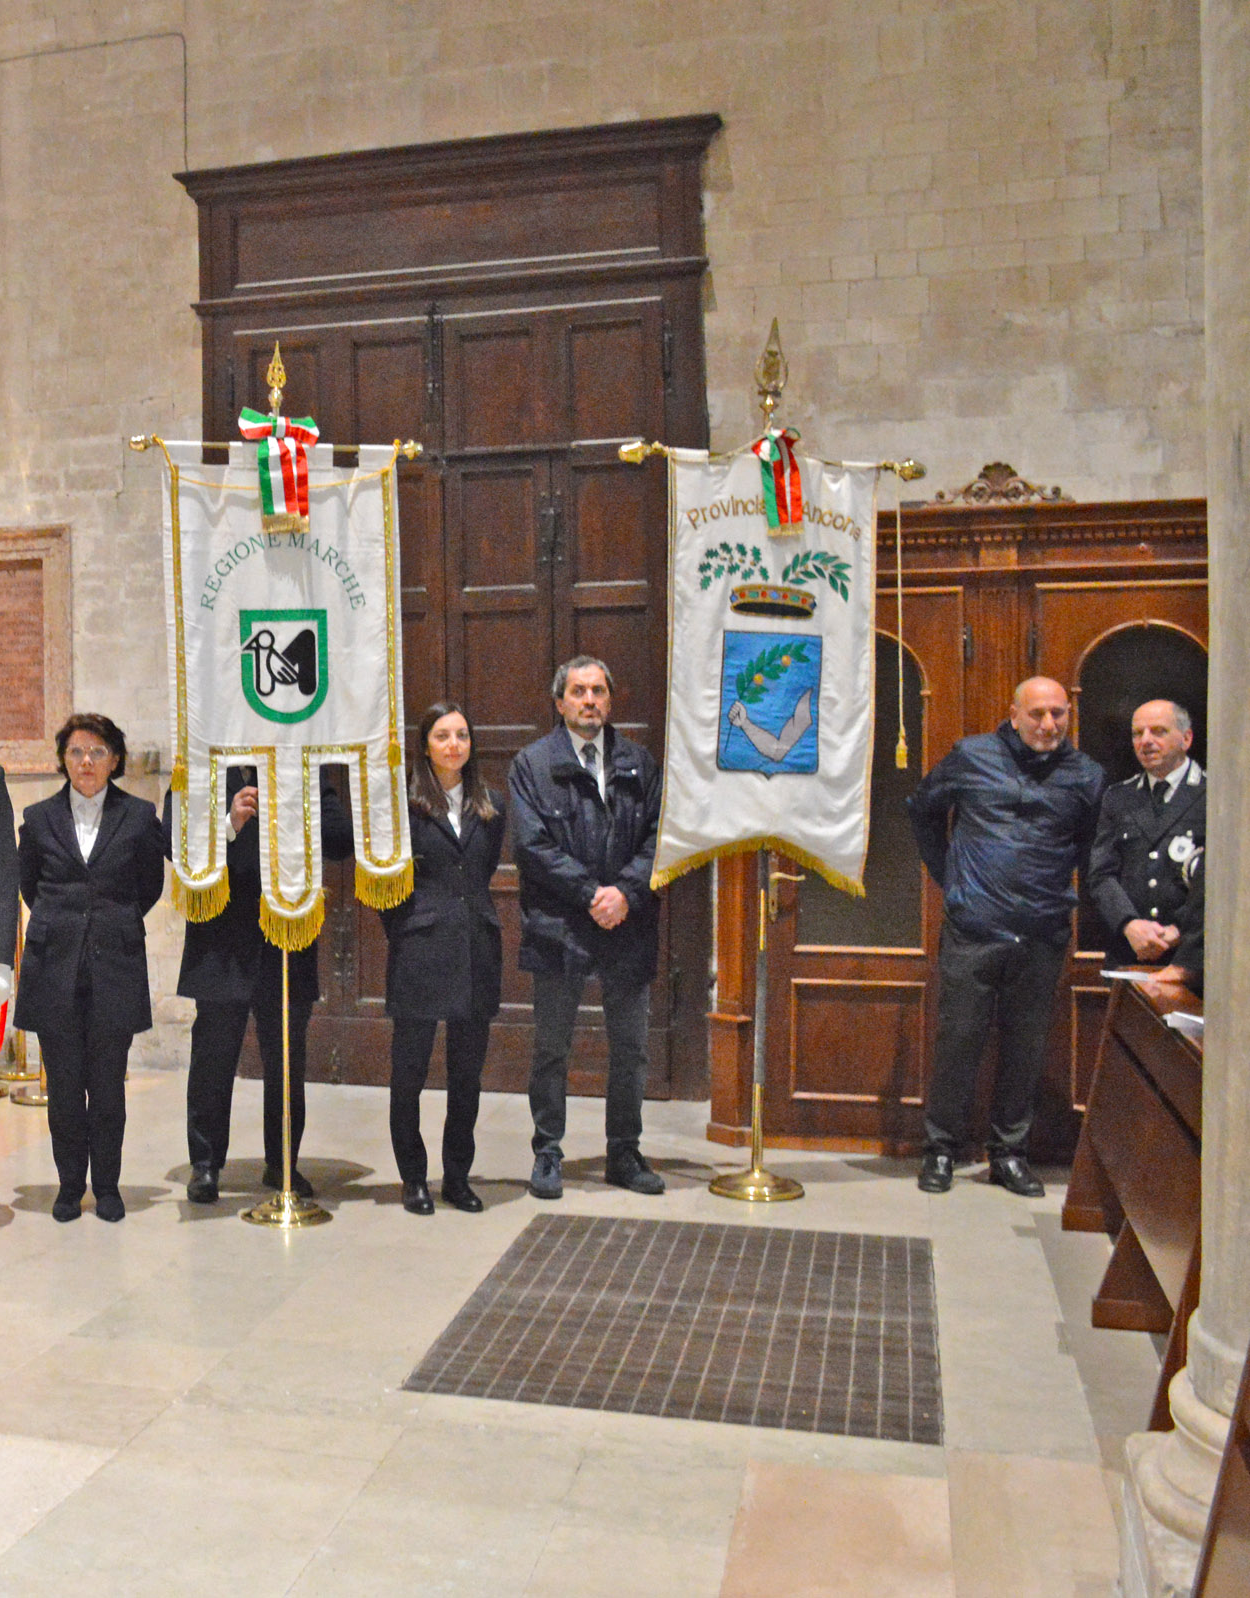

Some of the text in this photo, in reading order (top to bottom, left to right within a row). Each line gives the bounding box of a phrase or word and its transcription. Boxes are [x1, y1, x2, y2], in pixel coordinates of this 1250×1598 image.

[802, 501, 861, 541] Ancona
[200, 532, 366, 611] REGIONE MARCHE
